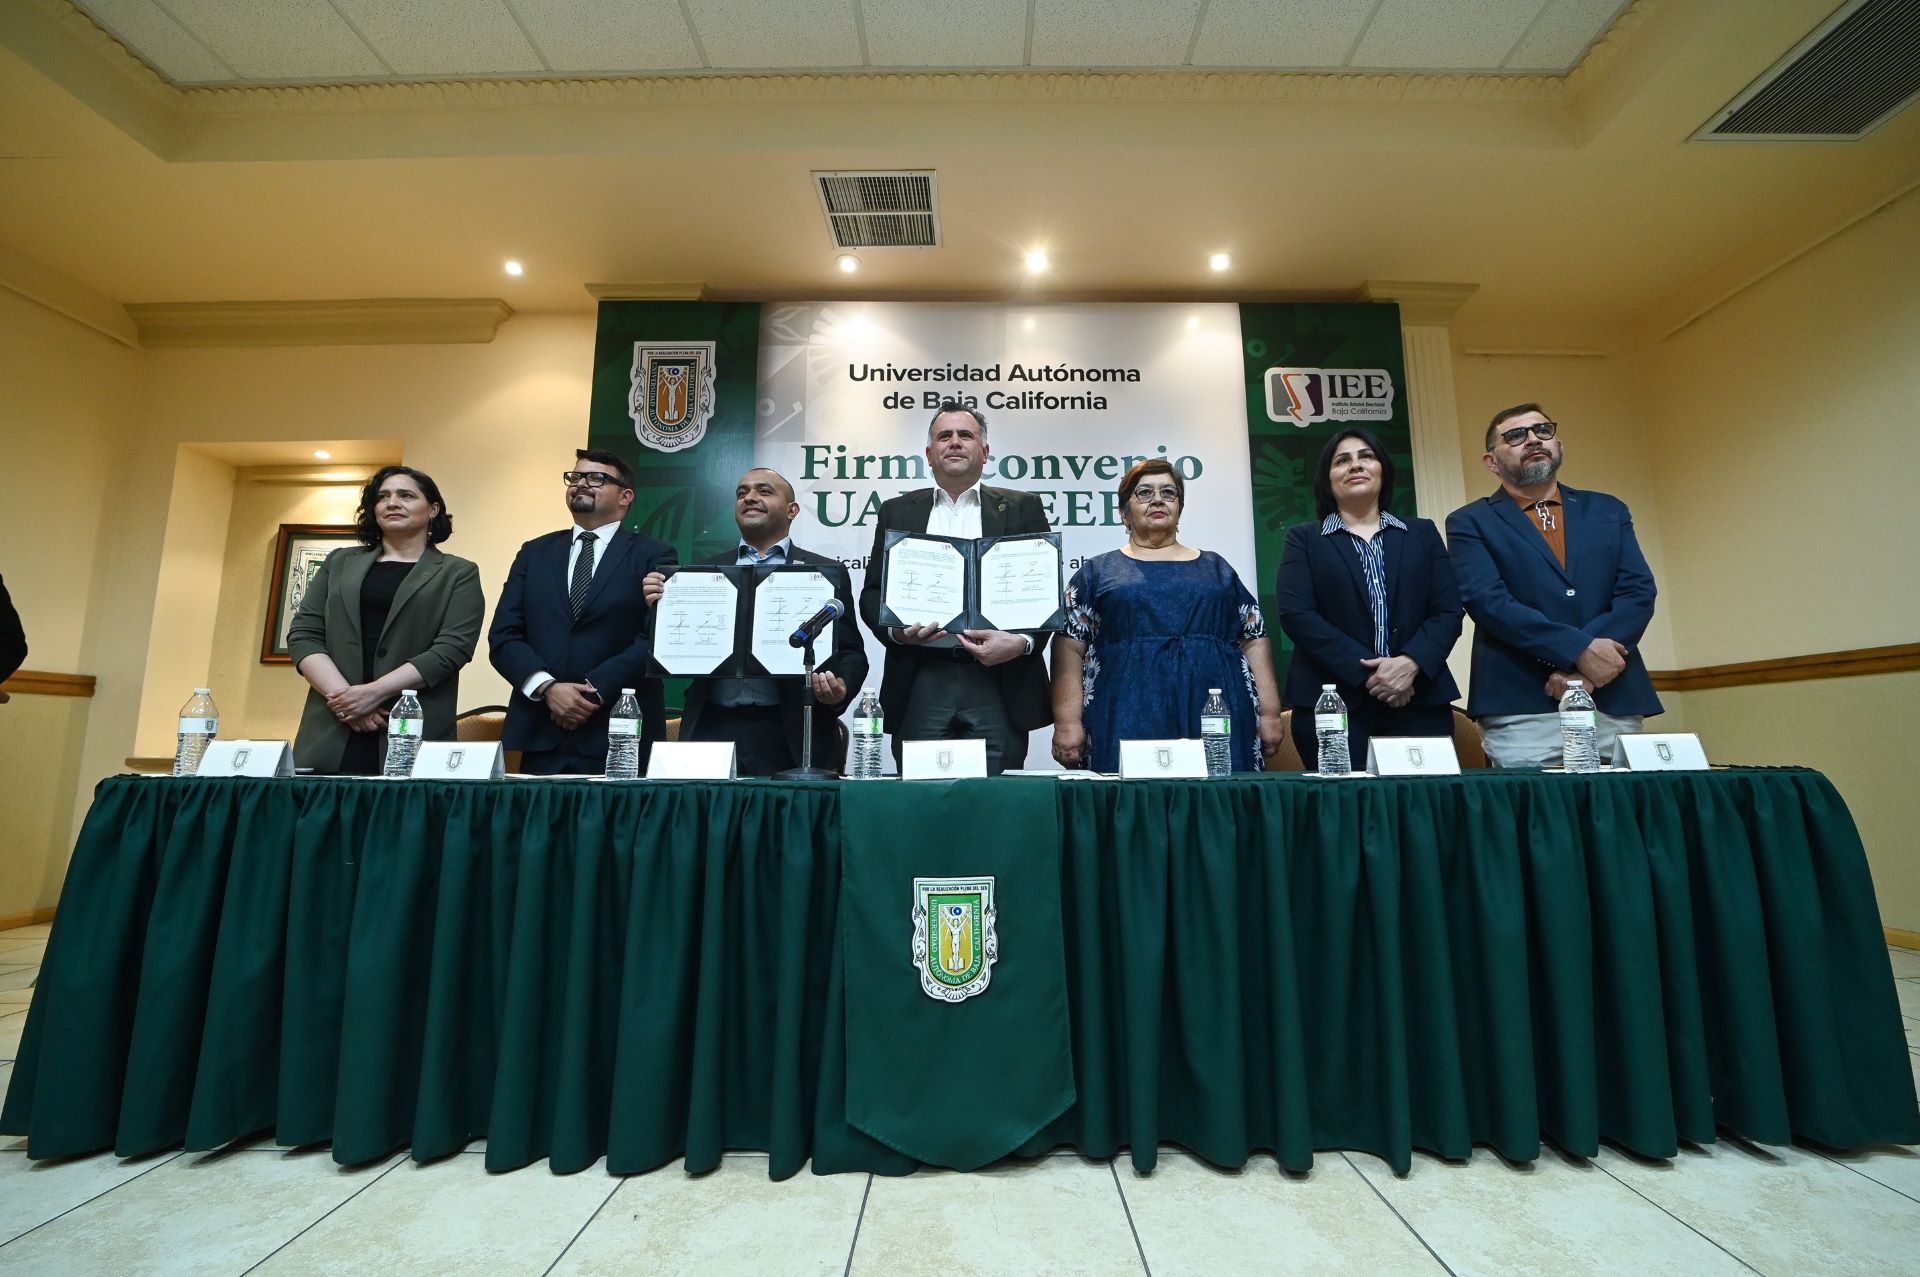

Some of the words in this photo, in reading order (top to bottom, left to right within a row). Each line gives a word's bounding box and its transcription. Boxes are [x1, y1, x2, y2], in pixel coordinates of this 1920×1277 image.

[849, 363, 1001, 382] Universidad
[1008, 363, 1141, 382] Autónoma
[650, 362, 658, 407] UNIVERSIDAD
[1326, 374, 1388, 399] IEE
[882, 391, 915, 410] de
[985, 391, 1108, 410] California
[1331, 407, 1349, 416] Baja
[1350, 407, 1387, 415] California
[800, 444, 934, 480] Firm
[930, 899, 938, 953] UNIVERSIDAD
[973, 899, 981, 951] CALIFORNIA
[971, 954, 981, 973] BAJA
[962, 972, 973, 981] DE
